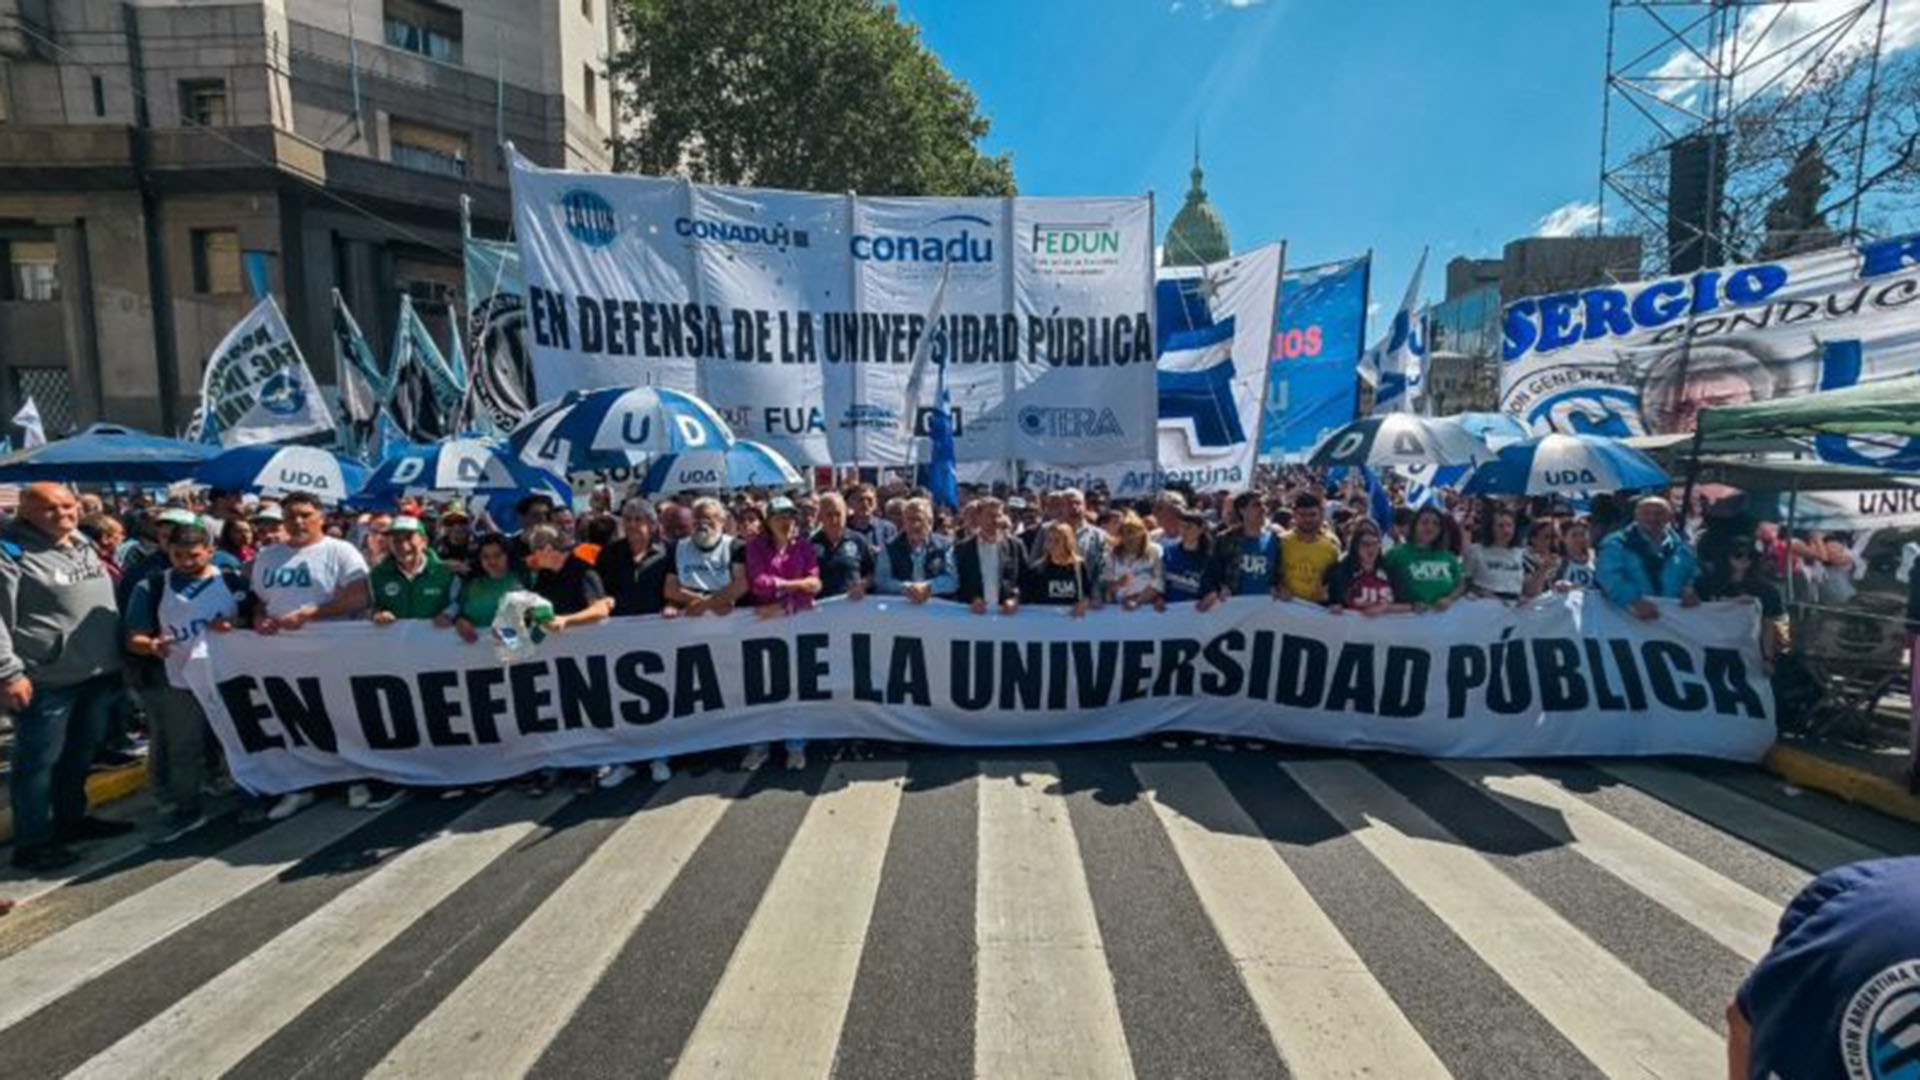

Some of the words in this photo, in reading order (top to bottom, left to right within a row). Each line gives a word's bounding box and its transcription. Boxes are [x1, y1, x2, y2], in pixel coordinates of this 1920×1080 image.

[849, 230, 993, 263] conadu
[1032, 223, 1119, 254] FEDUN
[530, 285, 571, 351] EN
[578, 296, 727, 359] DEFENSA
[734, 309, 773, 362] DE
[779, 311, 817, 363] LA
[823, 310, 1019, 364] UNIVERSIDAD
[1027, 306, 1154, 368] PÚBLICA
[1502, 265, 1787, 361] SERGIO
[764, 406, 826, 433] FUA
[1018, 404, 1124, 438] CTERA
[280, 468, 329, 489] UDA
[680, 469, 717, 484] UDA
[1117, 464, 1242, 494] Argentina
[1545, 470, 1596, 486] UDA
[262, 561, 313, 589] UDA
[215, 673, 339, 754] EN
[349, 643, 725, 751] DEFENSA
[742, 633, 833, 706] DE
[851, 633, 932, 708] LA
[950, 629, 1431, 718] UNIVERSIDAD
[1447, 624, 1767, 720] PÚBLICA
[1847, 967, 1911, 1028] ARGENTINA
